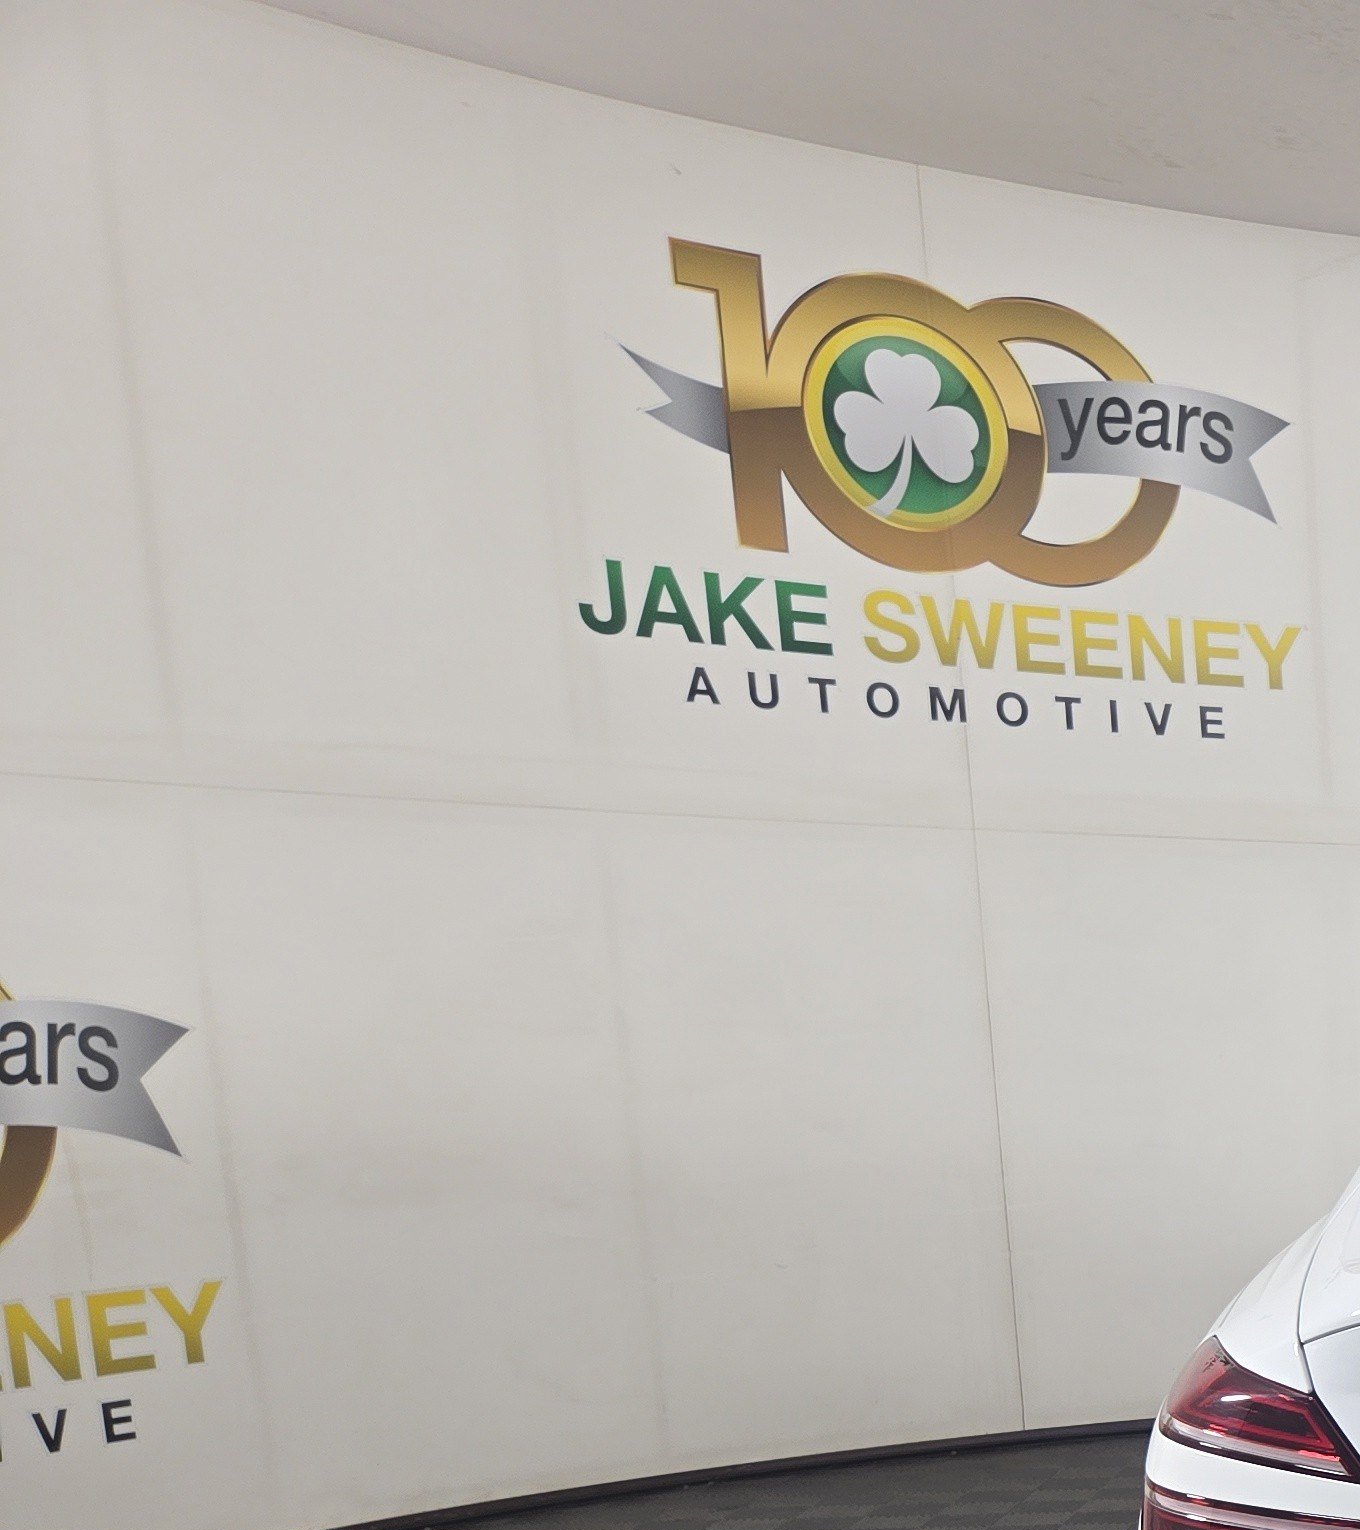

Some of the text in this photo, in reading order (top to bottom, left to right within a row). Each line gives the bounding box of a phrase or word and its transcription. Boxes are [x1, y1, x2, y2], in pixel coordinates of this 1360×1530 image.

[668, 236, 1181, 588] 100
[1057, 396, 1234, 463] years
[578, 558, 1303, 690] JAKE SWEENEY
[686, 666, 1226, 739] AUTOMOTIVE
[0, 1281, 222, 1390] NEY
[0, 1399, 137, 1462] VE
